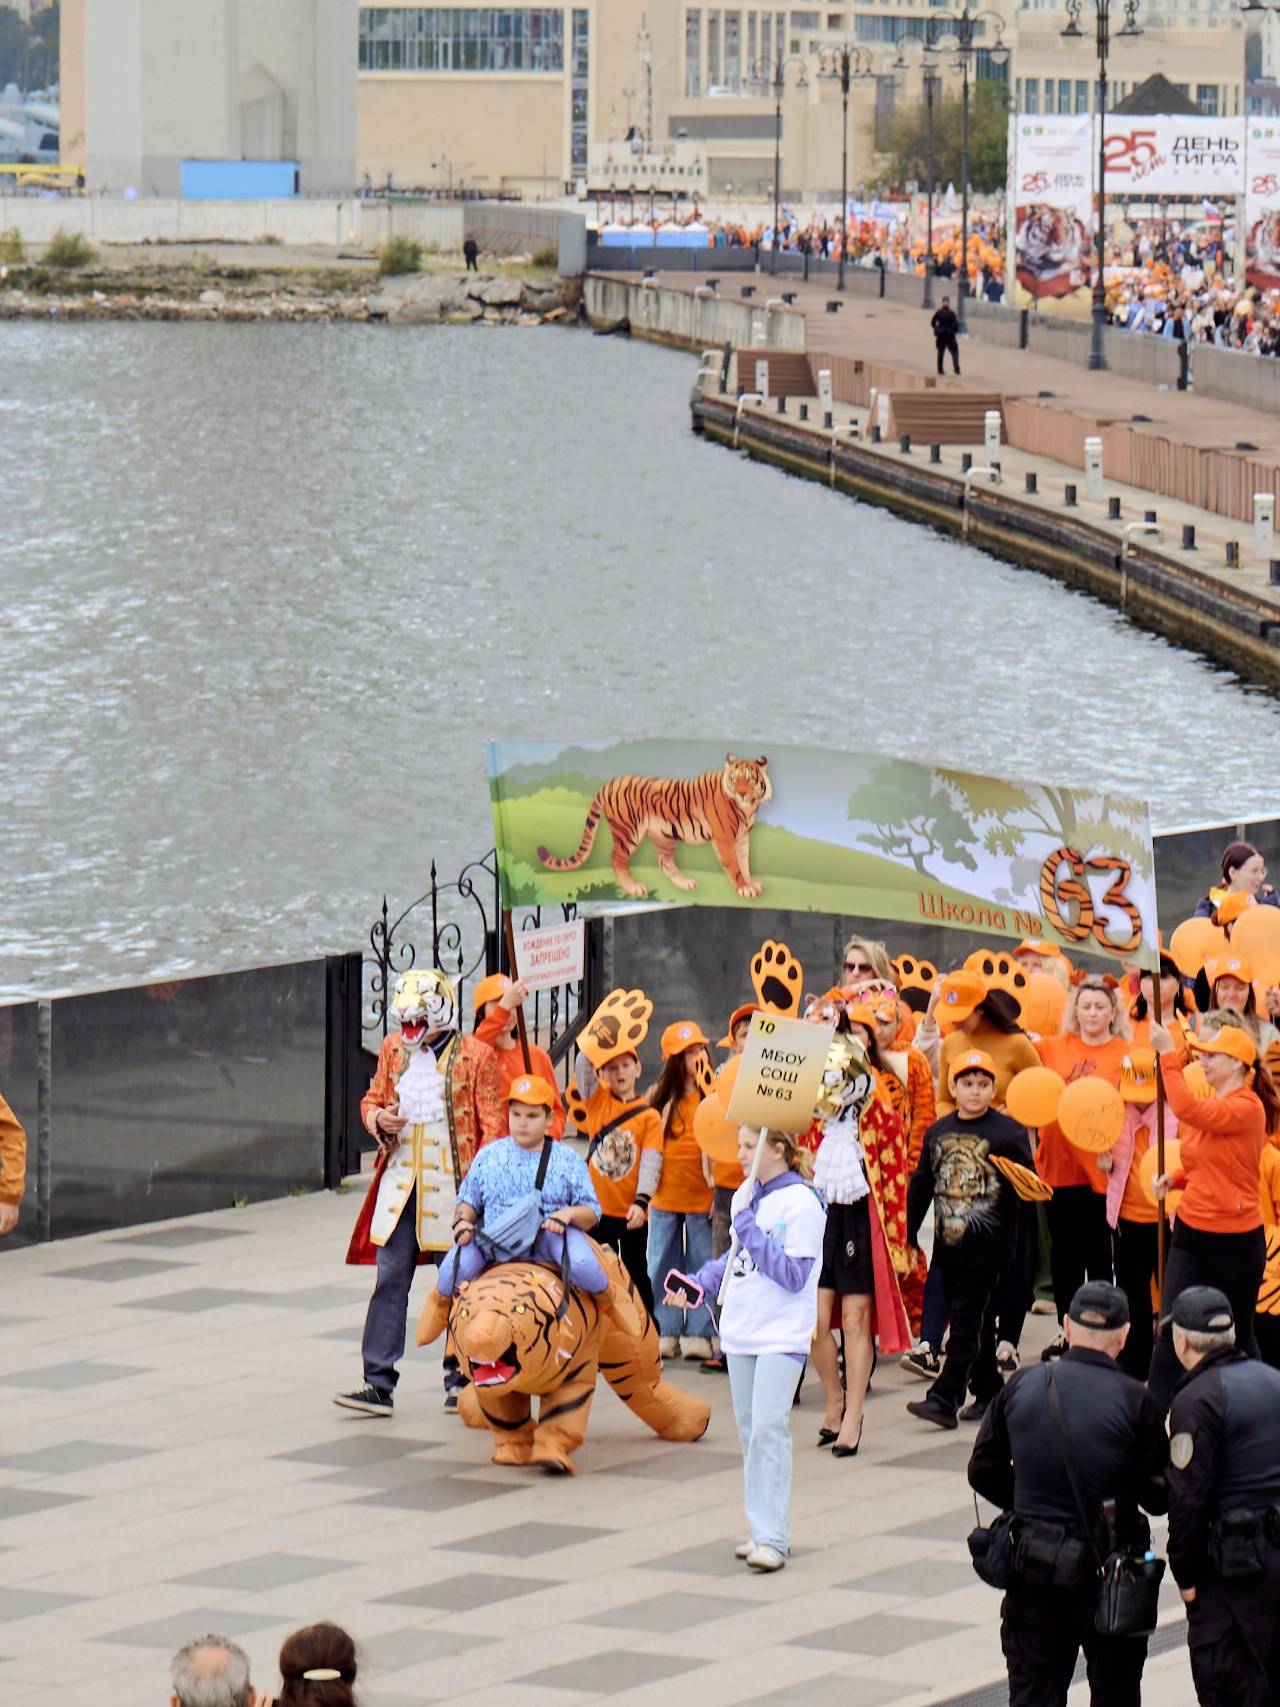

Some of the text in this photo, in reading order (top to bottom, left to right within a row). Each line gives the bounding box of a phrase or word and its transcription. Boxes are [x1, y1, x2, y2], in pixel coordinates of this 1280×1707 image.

[1103, 129, 1157, 173] 25
[1171, 136, 1240, 152] ДЕНЬ
[1171, 153, 1238, 166] ТИГРА
[918, 847, 1143, 957] Школа № 63
[759, 1020, 776, 1034] 10
[761, 1048, 807, 1067] МБОУ
[760, 1066, 798, 1084] СОШ
